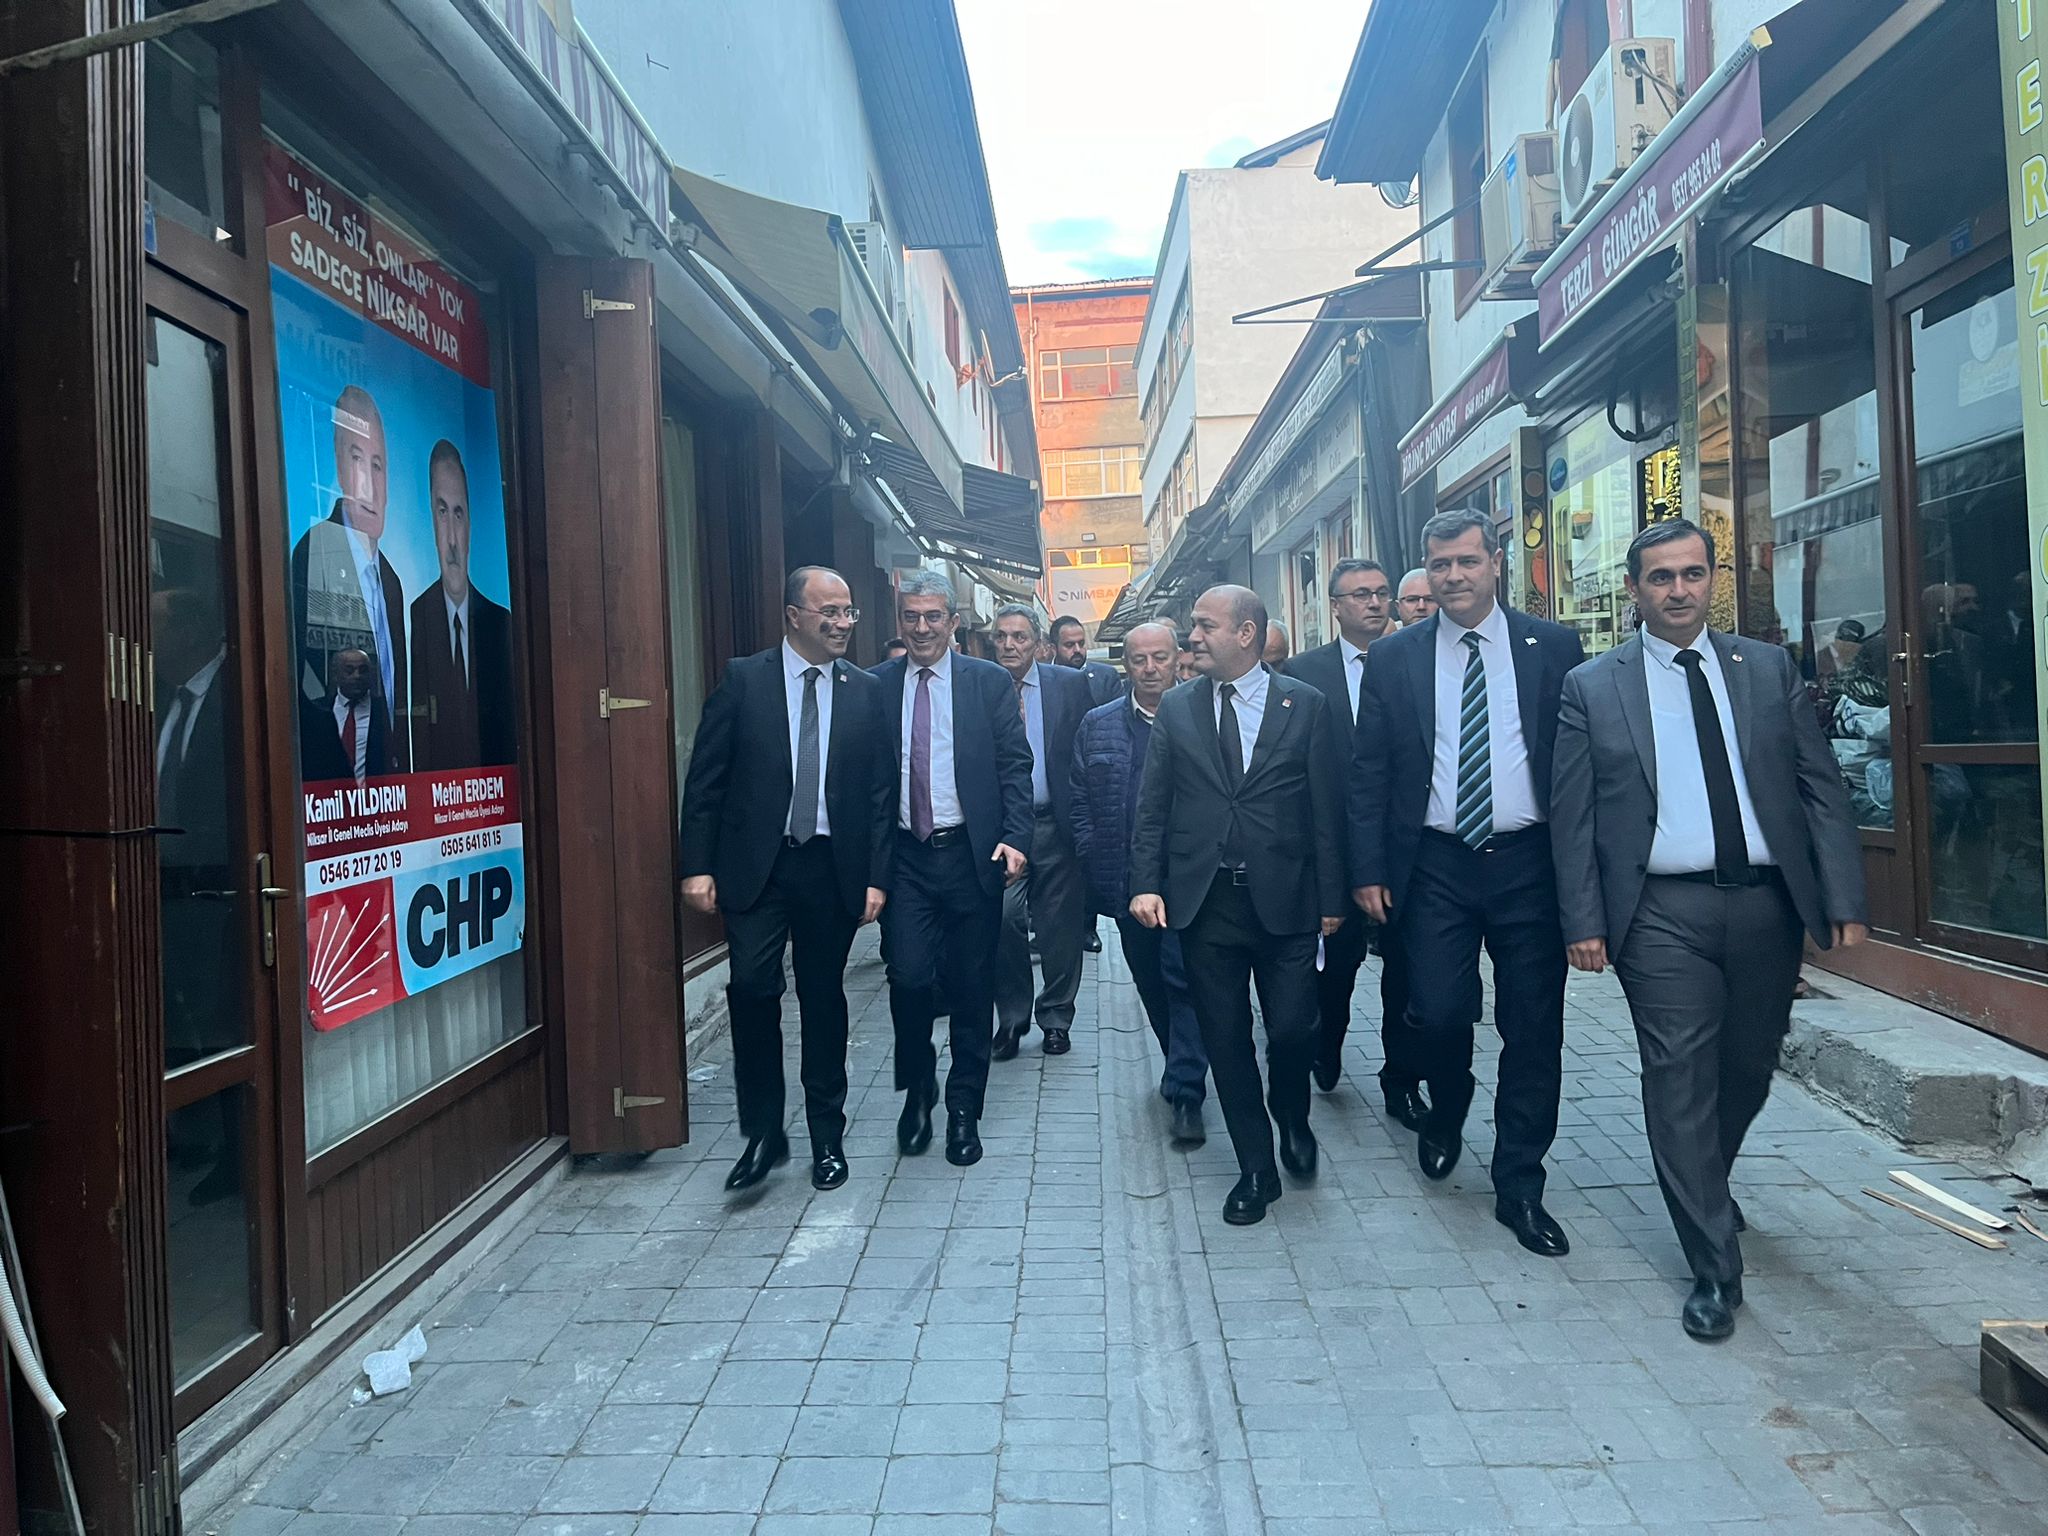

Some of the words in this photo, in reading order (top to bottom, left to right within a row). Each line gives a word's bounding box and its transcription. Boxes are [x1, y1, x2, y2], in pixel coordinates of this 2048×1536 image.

[342, 213, 374, 266] SİZ,
[437, 282, 465, 325] YOK
[1560, 243, 1593, 318] TERZİ
[1602, 185, 1662, 279] GÜNGÖR
[290, 231, 363, 304] SADECE
[366, 275, 429, 345] NİKSAR
[431, 322, 459, 363] VAR
[1425, 406, 1457, 461] DÜNYASI
[1070, 588, 1118, 601] NİMSA
[305, 789, 344, 825] Kamil
[347, 785, 407, 818] YILDIRIM
[431, 780, 463, 807] Metin
[464, 776, 504, 803] ERDEM
[307, 832, 327, 847] Niksar
[333, 826, 353, 842] Genel
[354, 825, 374, 839] Meclis
[374, 819, 391, 837] Üyesi
[391, 819, 409, 833] Adayı
[452, 809, 465, 821] Genel
[465, 807, 479, 819] Meclis
[441, 837, 464, 857] 0505
[466, 833, 481, 851] 641
[482, 831, 491, 848] 81
[492, 829, 501, 845] 15
[319, 860, 350, 885] 0546
[352, 856, 371, 878] 217
[374, 852, 388, 873] 20
[390, 849, 402, 869] 19
[406, 865, 513, 969] CHP
